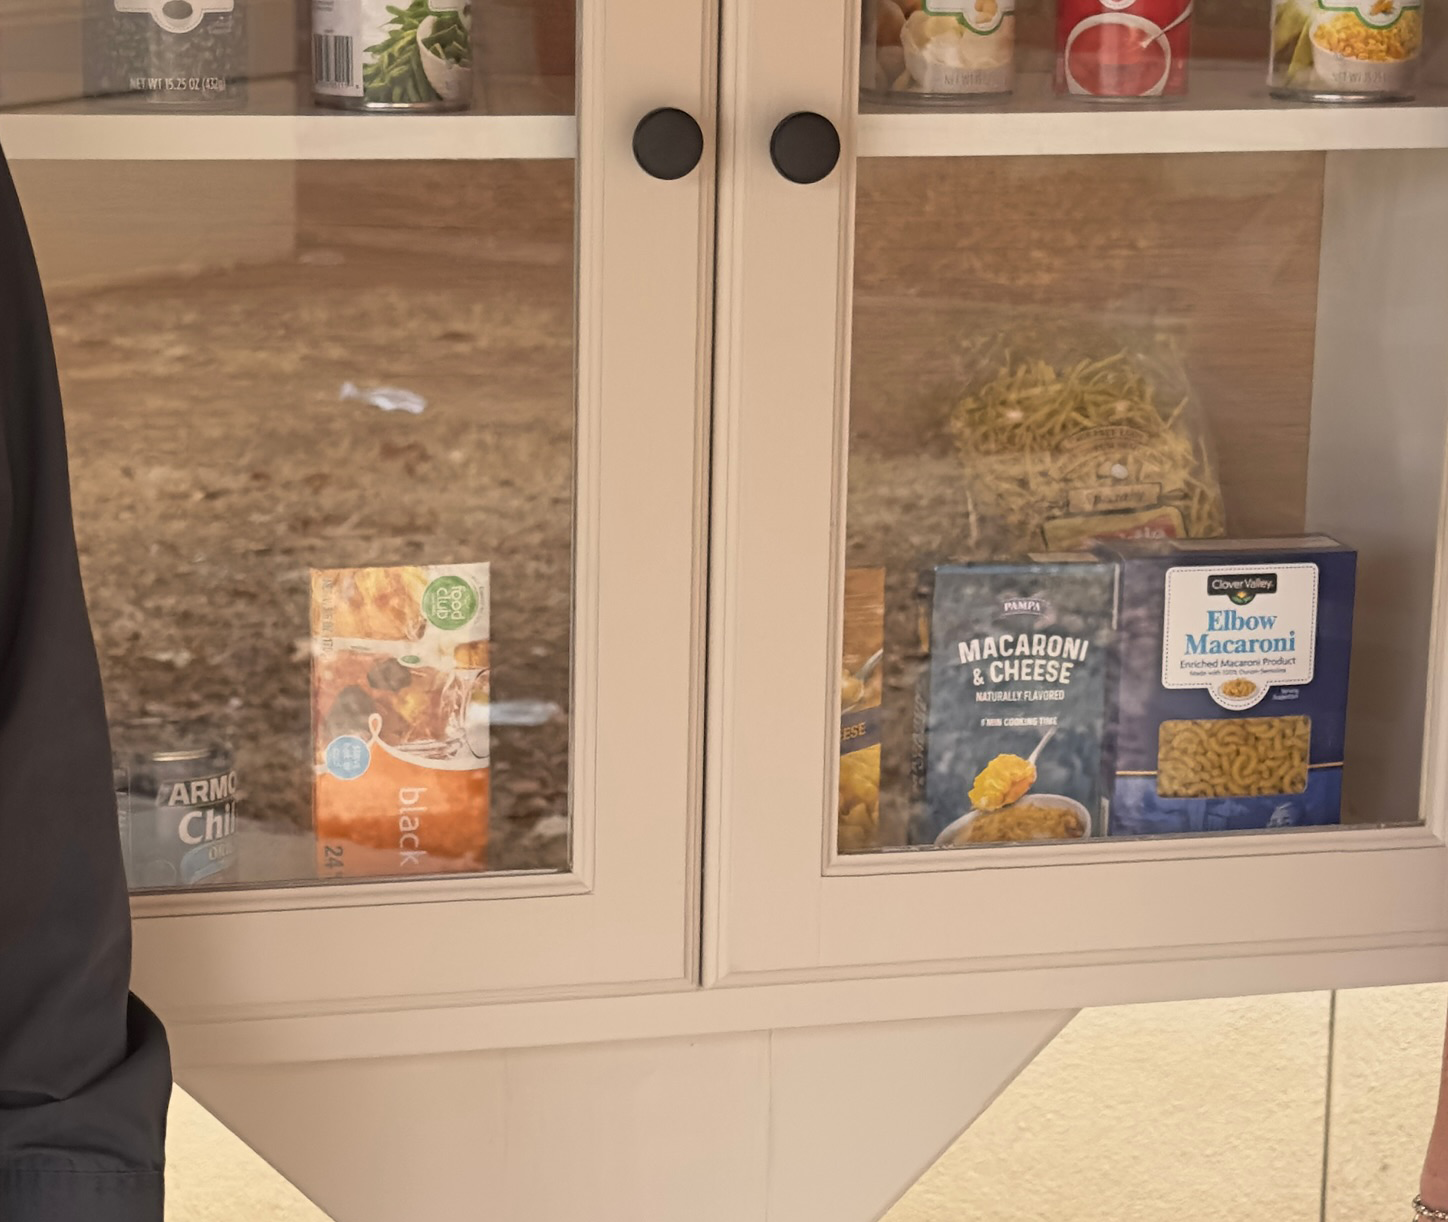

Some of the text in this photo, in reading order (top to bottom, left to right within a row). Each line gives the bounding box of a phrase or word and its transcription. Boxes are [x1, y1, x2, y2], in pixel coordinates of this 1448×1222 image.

[130, 77, 146, 90] NET
[148, 77, 163, 90] WT
[165, 77, 187, 90] 15.25
[188, 77, 200, 90] OZ
[1212, 578, 1272, 590] Clover Valley
[437, 587, 452, 620] club
[451, 585, 466, 620] food
[1003, 600, 1041, 612] PAMPA
[1207, 609, 1277, 632] Elbow
[958, 633, 1089, 664] MACARONI
[1184, 631, 1295, 655] Macaroni
[972, 659, 1074, 686] & CHEESE
[1180, 656, 1296, 669] Enriched Macaroni Product
[975, 689, 1065, 702] NATURALLY FLAVORED
[1004, 717, 1038, 727] COOKING
[399, 787, 427, 866] black
[324, 845, 344, 868] 24
